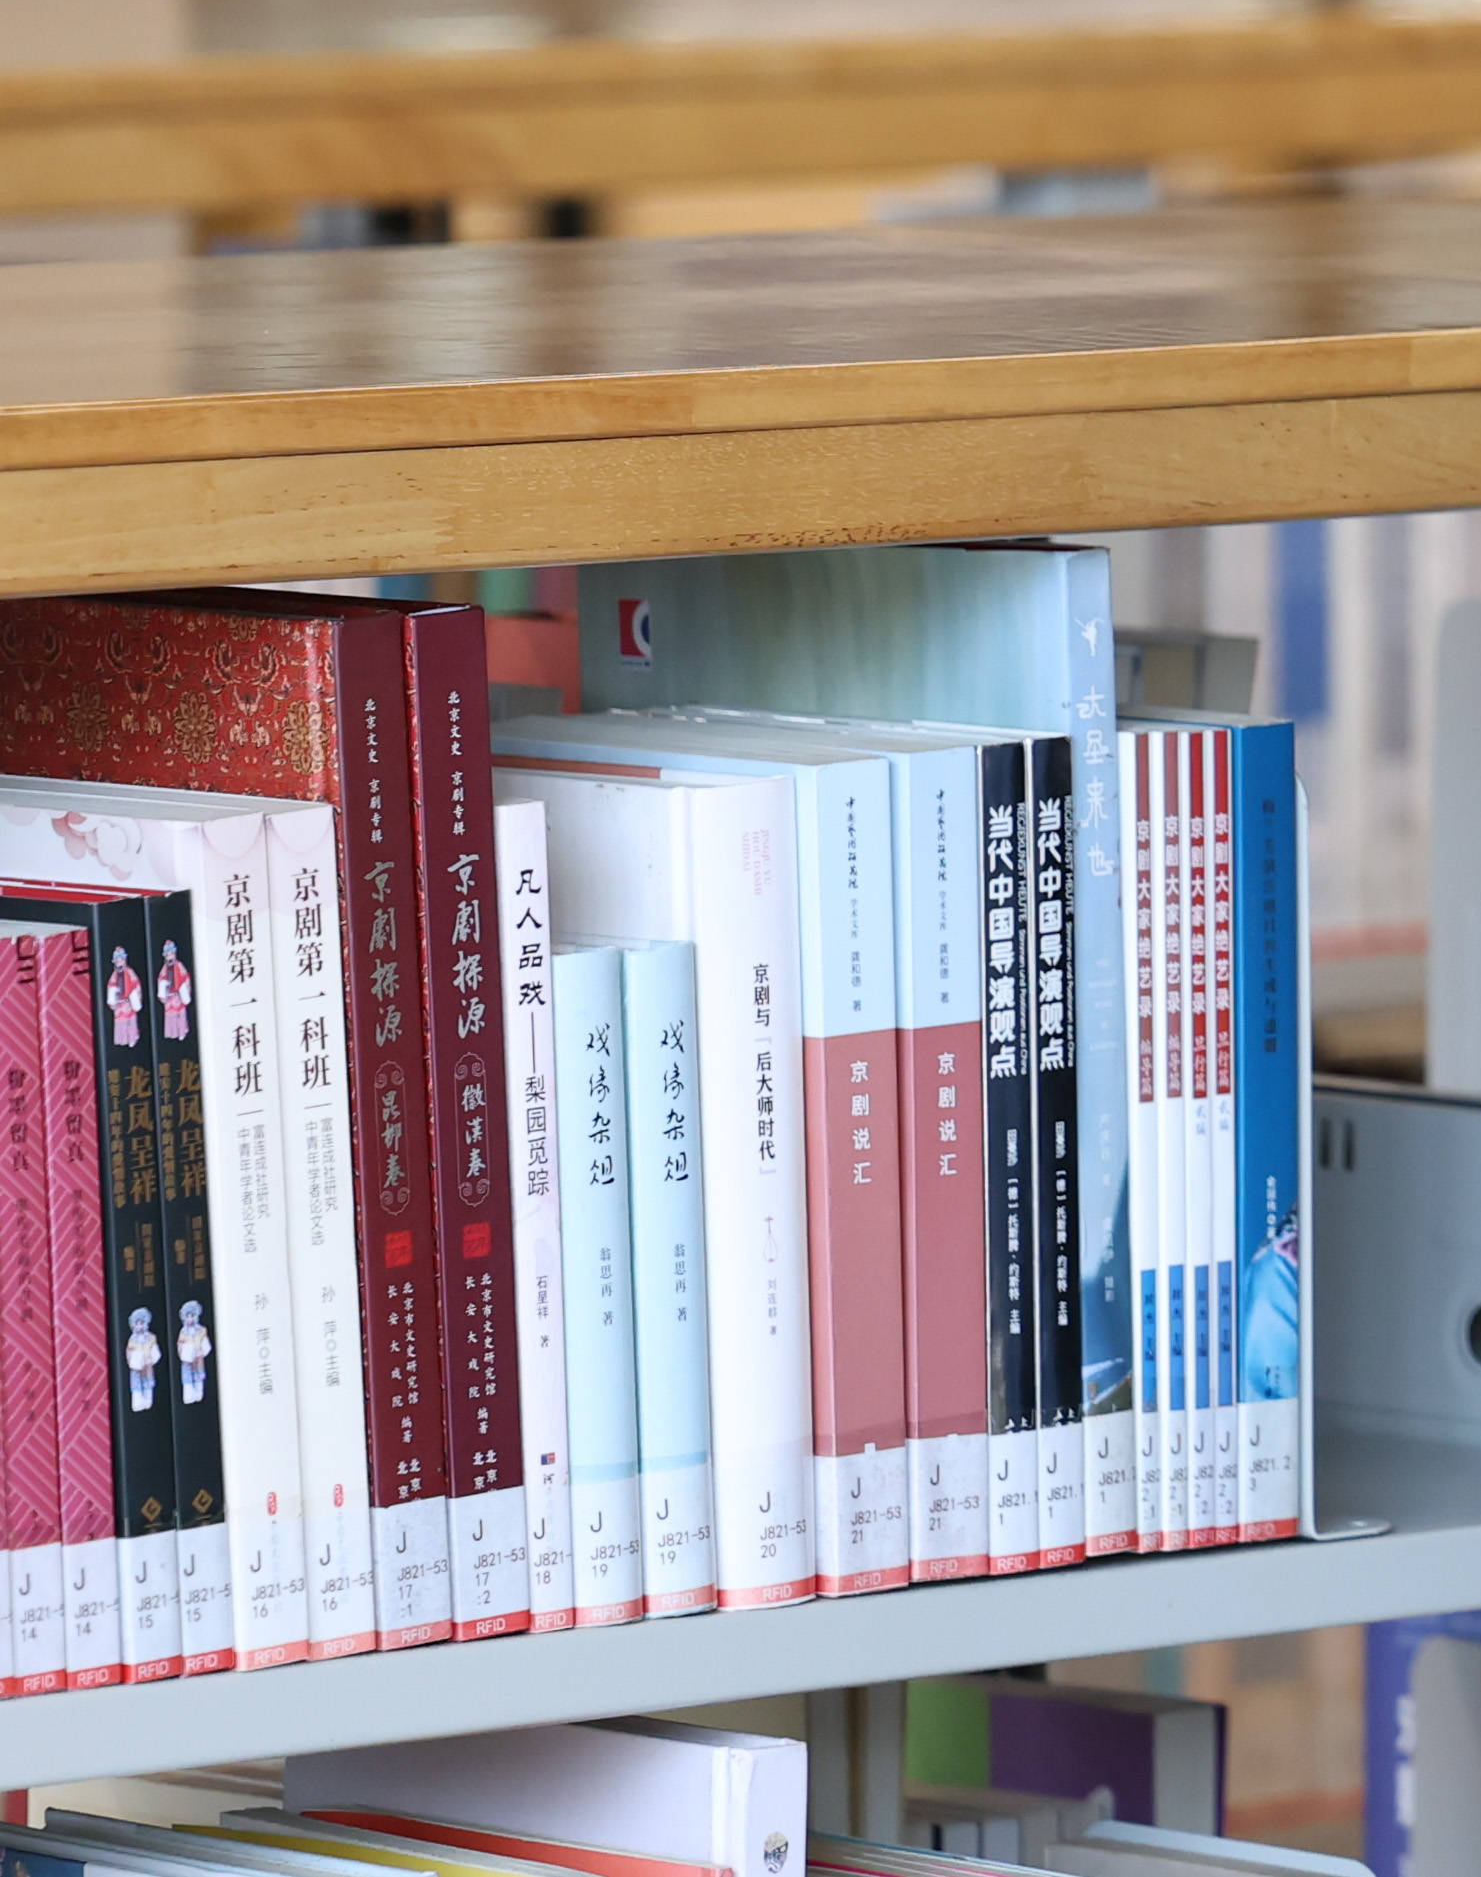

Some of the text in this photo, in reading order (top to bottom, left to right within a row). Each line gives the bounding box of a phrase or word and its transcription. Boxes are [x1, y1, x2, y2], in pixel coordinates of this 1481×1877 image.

[364, 698, 379, 764] 北京文史
[448, 691, 462, 756] 北京文史
[1137, 819, 1153, 1018] 京剧大家绝艺录
[1164, 816, 1181, 1014] 京剧大家绝艺录
[1190, 817, 1206, 1013] 京剧大家绝艺录
[1214, 813, 1230, 1009] 京剧大家绝艺录
[515, 868, 547, 1007] 凡人品戏
[988, 803, 1017, 1080] 当代中国导演观点
[1038, 796, 1065, 1072] 当代中国导演观点
[223, 874, 264, 1096] 京剧第一科班
[291, 867, 331, 1090] 京剧第一科班
[850, 1061, 872, 1184] 京剧说汇
[937, 1052, 957, 1176] 京剧说汇
[126, 1065, 157, 1205] 龙凤呈祥
[176, 1060, 207, 1199] 龙凤呈祥
[253, 1124, 270, 1219] 富连成社研究
[320, 1117, 338, 1212] 富连成社研究
[599, 1248, 613, 1326] 翁思再 著
[673, 1243, 687, 1322] 翁思再 著
[402, 1282, 420, 1406] 北京市文史研究馆
[464, 1275, 481, 1400] 长安大戏院
[480, 1272, 498, 1397] 北京市文史研究馆
[387, 1284, 404, 1409] 长安大戏院
[401, 1415, 414, 1445] 编著
[477, 1406, 490, 1436] 编著
[1142, 1436, 1152, 1457] J
[1171, 1433, 1181, 1454] J
[1195, 1432, 1205, 1453] J
[1219, 1431, 1230, 1452] J
[1250, 1425, 1260, 1446] J
[1098, 1437, 1109, 1459] J
[997, 1459, 1009, 1481] J
[1047, 1452, 1058, 1474] J
[930, 1464, 940, 1485] J
[850, 1477, 861, 1499] J
[656, 1498, 670, 1520] J
[759, 1491, 772, 1513] J
[929, 1495, 980, 1515] J821-53
[590, 1511, 602, 1533] J
[851, 1505, 901, 1527] J821-53
[929, 1516, 942, 1531] 21
[472, 1519, 483, 1541] J
[534, 1518, 545, 1540] J
[658, 1525, 711, 1549] J821-53
[851, 1530, 864, 1544] 21
[396, 1531, 407, 1553] J
[761, 1544, 777, 1558] 20
[1099, 1534, 1129, 1549] RFID
[183, 1554, 195, 1576] J
[250, 1550, 262, 1573] J
[320, 1544, 331, 1567] J
[474, 1546, 526, 1570] J821-53
[660, 1551, 676, 1566] 19
[930, 1558, 959, 1574] RFID
[997, 1555, 1027, 1571] RFID
[1047, 1548, 1075, 1564] RFID
[73, 1568, 86, 1590] J
[136, 1561, 147, 1583] J
[397, 1559, 449, 1582] J821-53
[475, 1572, 490, 1587] 17
[535, 1571, 551, 1585] 18
[592, 1564, 608, 1578] 19
[854, 1572, 881, 1588] RFID
[19, 1573, 31, 1596] J
[251, 1577, 305, 1601] J821-53
[399, 1585, 412, 1600] 17
[762, 1585, 792, 1602] RFID
[321, 1597, 338, 1612] 16
[661, 1589, 695, 1608] RFID
[138, 1615, 154, 1629] 15
[186, 1608, 202, 1623] 15
[253, 1604, 268, 1619] 16
[535, 1611, 567, 1629] RFID
[593, 1603, 625, 1621] RFID
[22, 1627, 37, 1641] 14
[76, 1623, 92, 1637] 14
[401, 1626, 432, 1645] RFID
[476, 1617, 506, 1635] RFID
[253, 1647, 286, 1664] RFID
[323, 1639, 355, 1656] RFID
[138, 1662, 169, 1679] RFID
[185, 1654, 218, 1672] RFID
[23, 1674, 56, 1691] RFID
[77, 1669, 109, 1686] RFID
